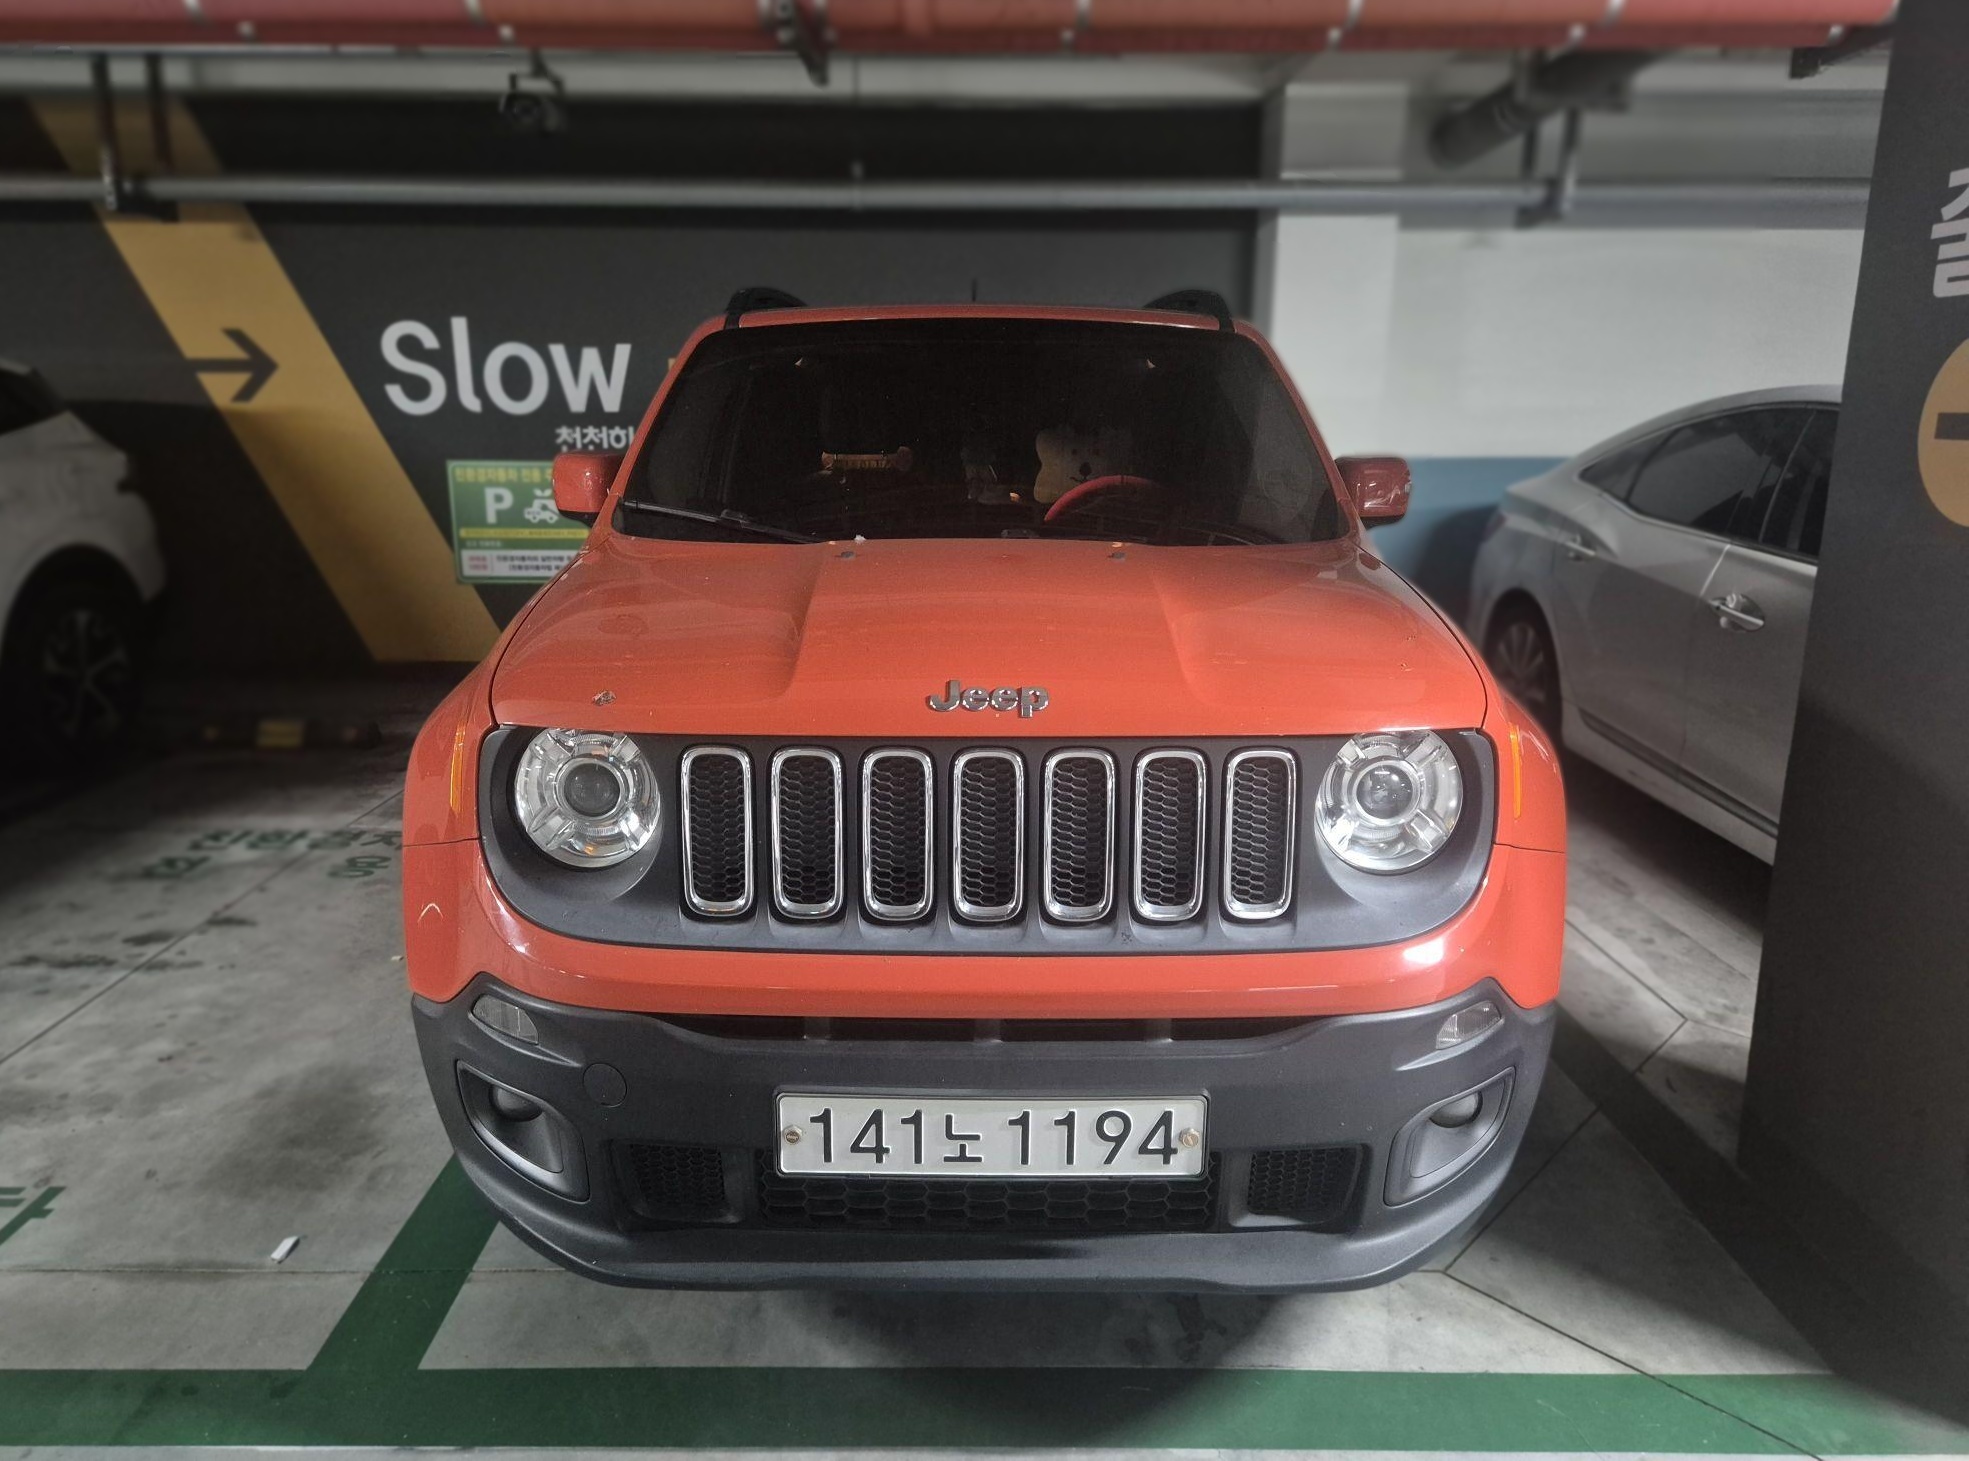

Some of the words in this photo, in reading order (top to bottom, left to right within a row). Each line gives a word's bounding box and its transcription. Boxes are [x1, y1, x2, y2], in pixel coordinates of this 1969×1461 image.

[380, 316, 631, 415] Slow
[484, 486, 514, 525] P
[926, 680, 1048, 718] Jeep
